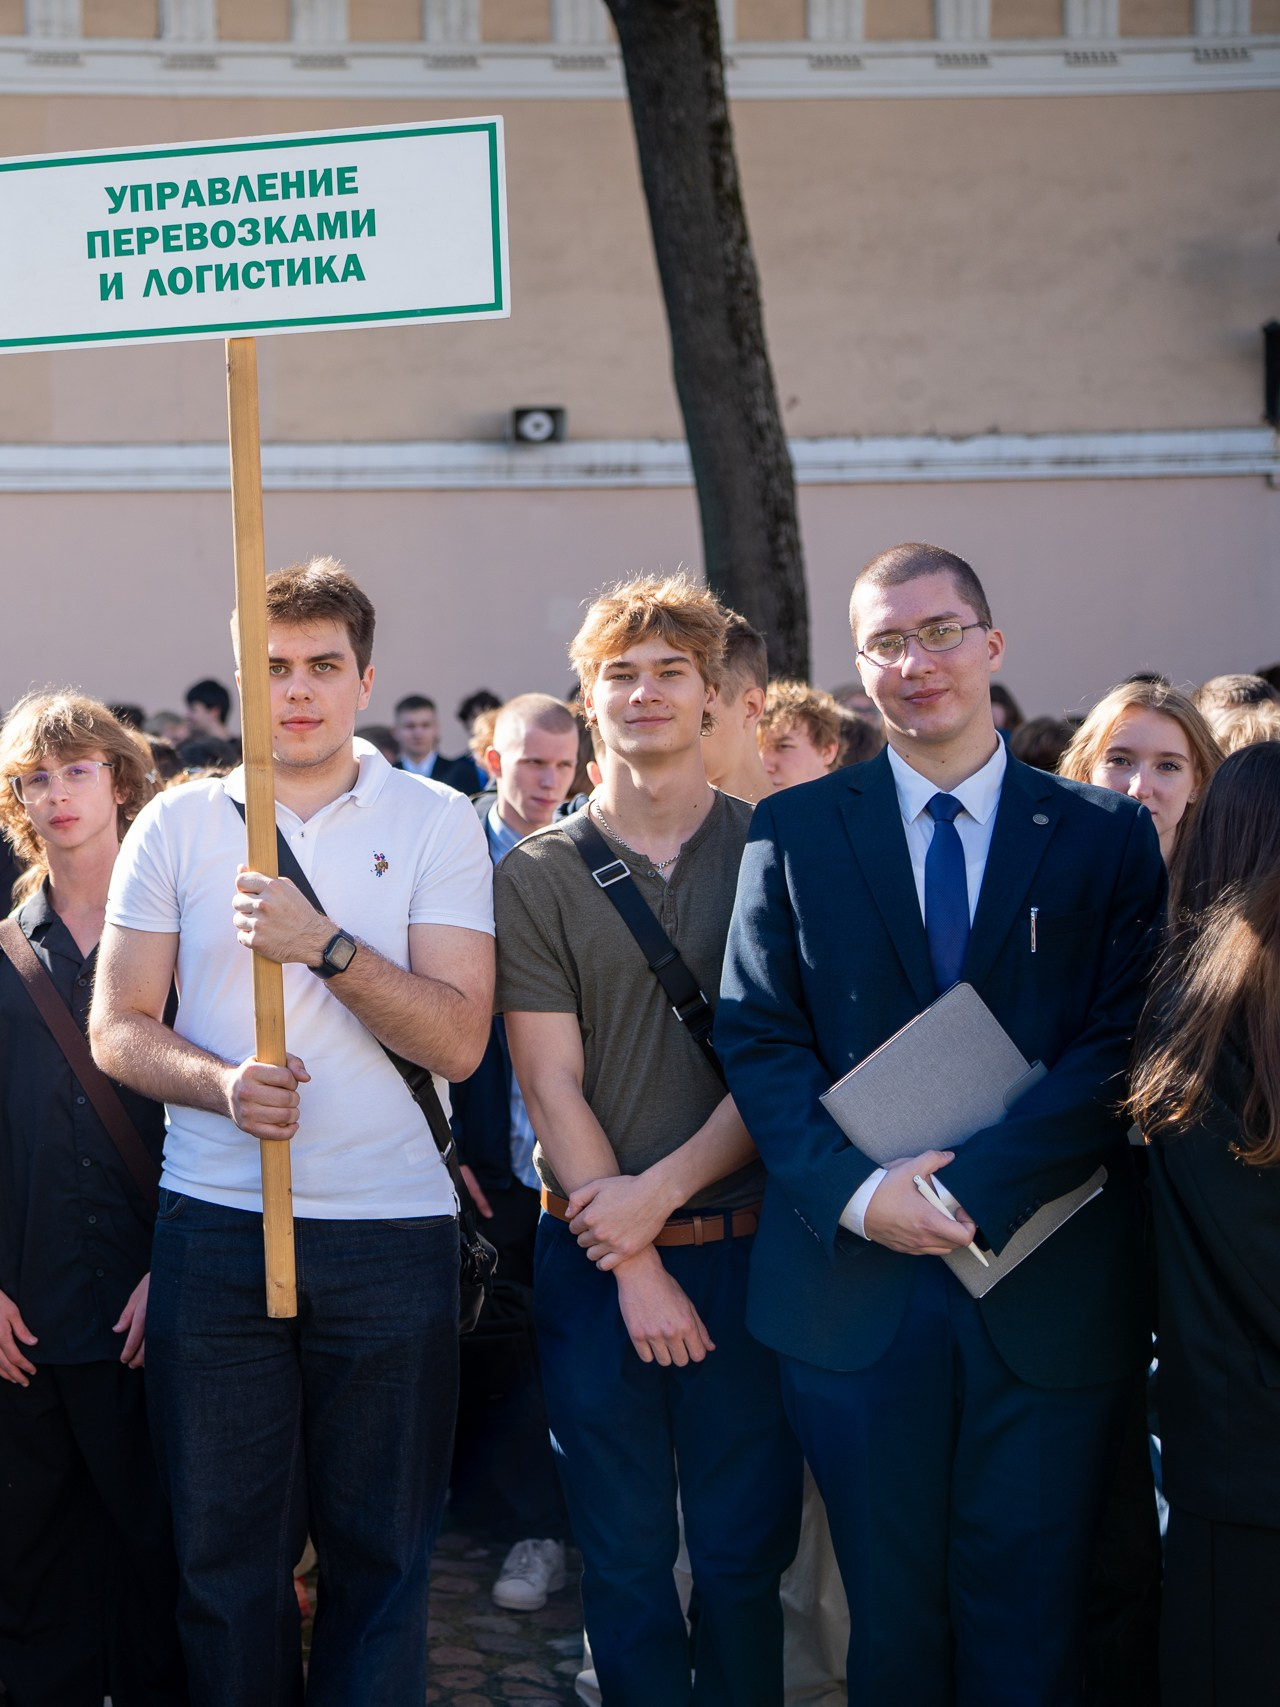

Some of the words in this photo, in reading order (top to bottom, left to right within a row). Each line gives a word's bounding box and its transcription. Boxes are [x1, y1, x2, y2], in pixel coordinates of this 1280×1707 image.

[104, 165, 359, 214] УПРАВЛЕНИЕ
[86, 208, 377, 260] ПЕРЕВОЗКАМИ
[99, 271, 124, 301] И
[142, 253, 366, 298] ЛОГИСТИКА
